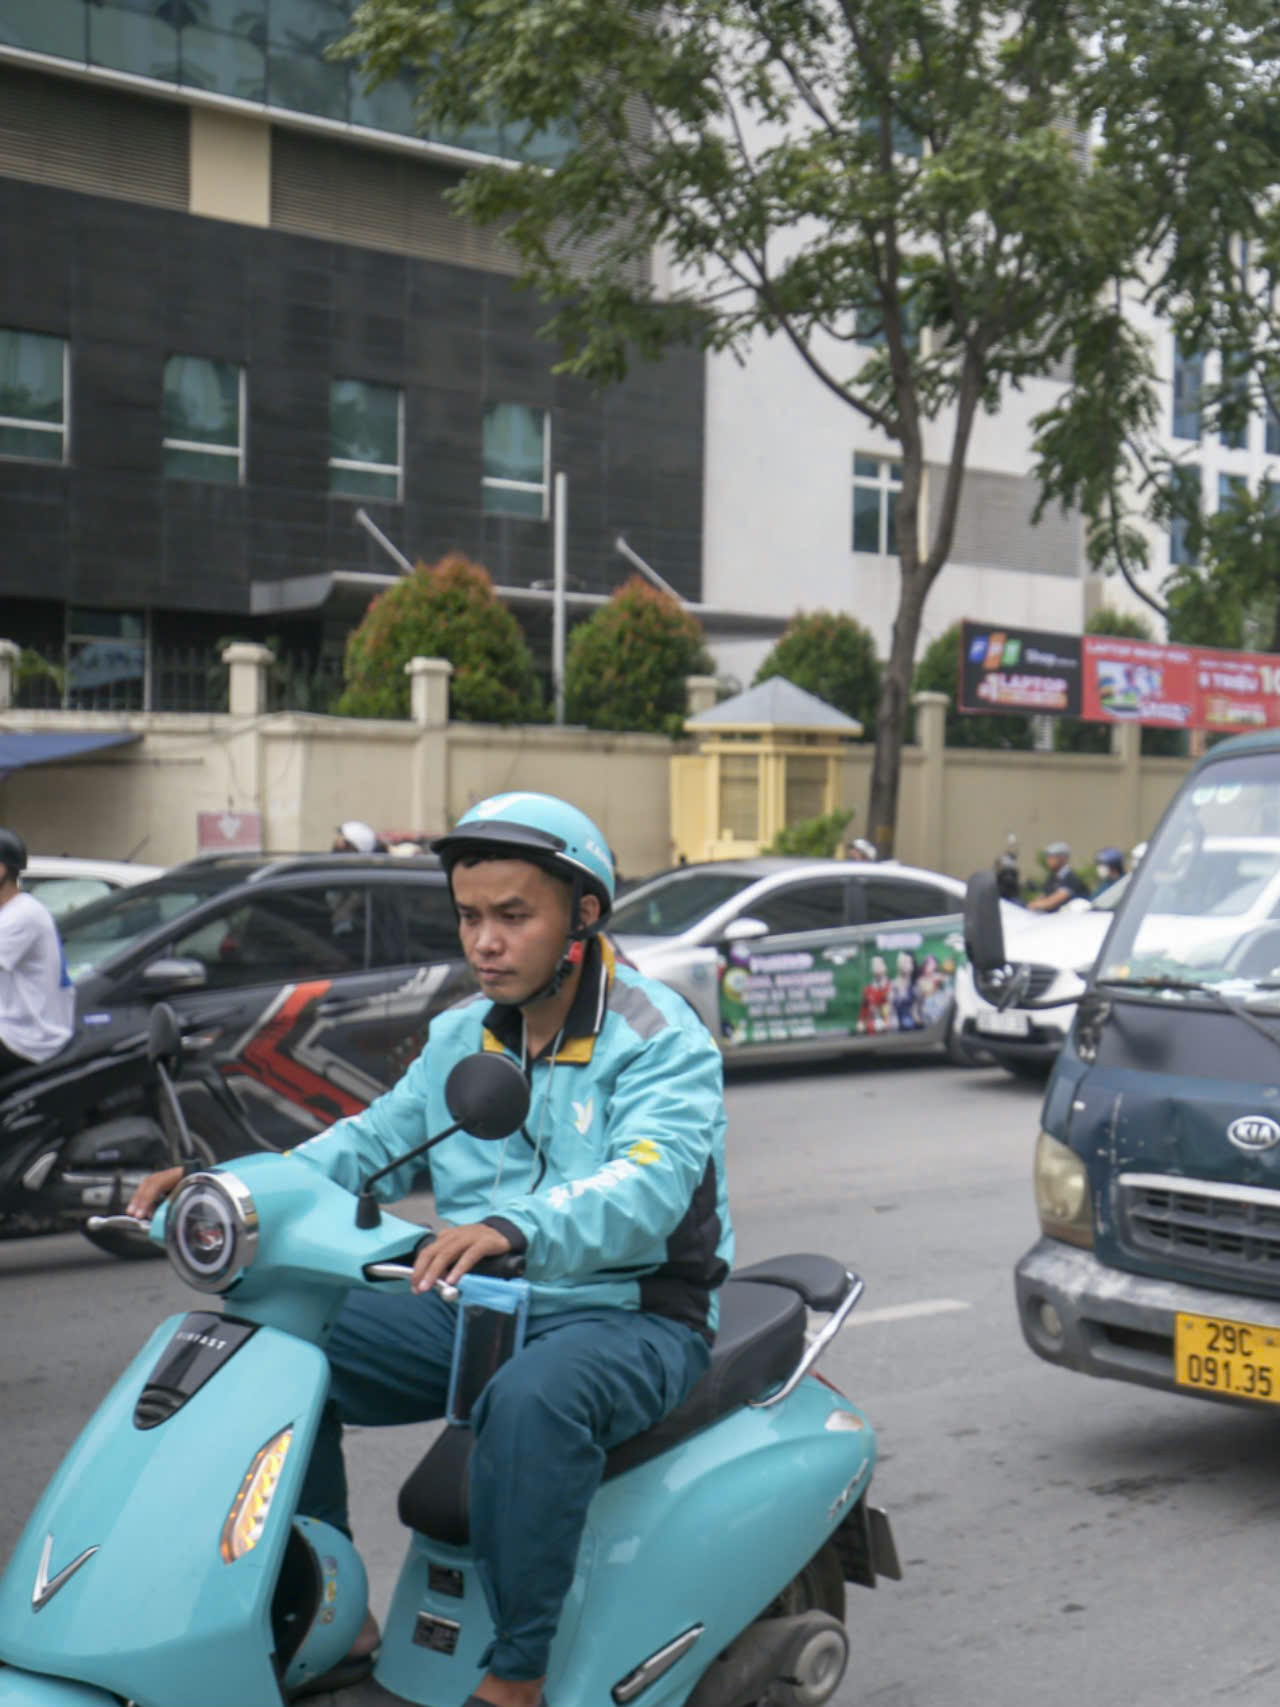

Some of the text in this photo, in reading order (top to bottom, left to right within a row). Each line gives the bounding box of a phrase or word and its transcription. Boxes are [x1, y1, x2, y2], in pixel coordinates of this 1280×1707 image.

[970, 634, 1021, 668] FPT
[1237, 1122, 1271, 1142] KIA
[1207, 1322, 1253, 1356] 29C
[1188, 1354, 1272, 1396] 091.35
